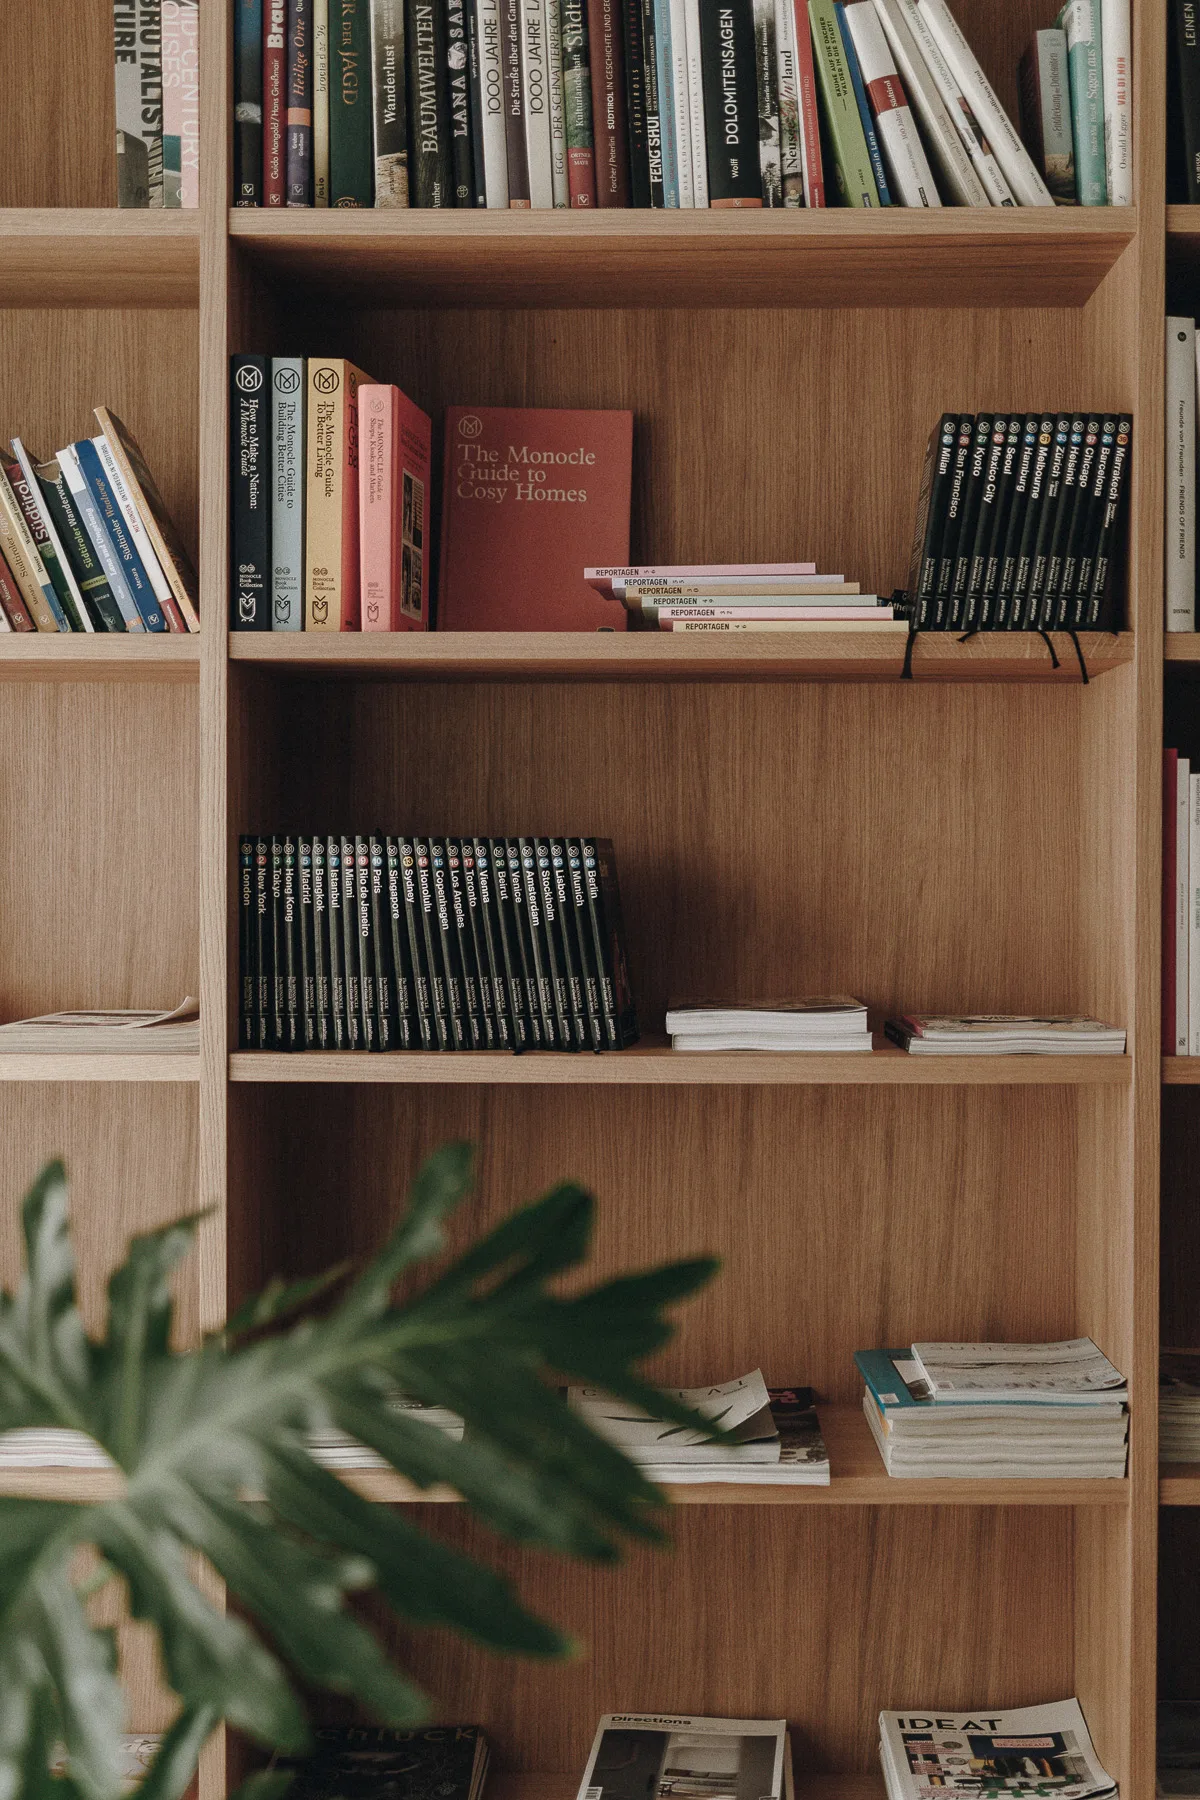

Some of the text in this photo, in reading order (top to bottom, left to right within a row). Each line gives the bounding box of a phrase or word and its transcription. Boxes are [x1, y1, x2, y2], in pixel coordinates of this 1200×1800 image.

[603, 14, 611, 31] UND
[1183, 3, 1197, 47] LEINEN
[292, 18, 308, 96] Heilige Orte
[337, 22, 358, 105] DER JAGD
[484, 19, 501, 115] 1000 JAHRE
[508, 24, 521, 115] Die Straße über den
[527, 19, 544, 115] 1000 JAHRE
[604, 34, 613, 80] GESCHICHTE
[271, 59, 279, 96] Grießmair
[383, 45, 396, 124] Wanderlust
[416, 5, 438, 153] BAUMWELTEN
[569, 54, 584, 126] Kulturlandschaft
[719, 9, 739, 178] Wolff DOLOMITENSAGEN
[884, 80, 898, 107] Südtirol
[1118, 78, 1126, 87] DI
[452, 76, 468, 137] LANA
[606, 92, 615, 129] SÜDTIROL
[1118, 90, 1126, 105] VAL
[1119, 113, 1128, 137] Egger
[552, 116, 564, 174] EGG DER
[647, 116, 662, 183] FENG SHUI
[869, 131, 887, 188] Kirchen in Lana
[1118, 140, 1127, 169] Oswald
[271, 157, 279, 179] Guido
[240, 408, 249, 446] Monocle
[249, 398, 258, 420] How
[249, 422, 257, 433] to
[1179, 400, 1187, 429] Freunde
[101, 444, 113, 466] SÜDTIROL
[249, 436, 259, 462] Make
[276, 402, 287, 502] Building Better Cities
[286, 402, 296, 509] The Monocle Guide to
[315, 402, 326, 478] To Better Living
[324, 402, 335, 497] The Monocle Guide
[458, 444, 596, 465] The Monocle
[240, 449, 250, 476] Guide
[458, 462, 546, 482] Guide to
[938, 447, 951, 475] Milan
[972, 447, 987, 477] Kyoto
[983, 446, 1001, 503] Mexico City
[1003, 446, 1015, 475] Seoul
[1016, 447, 1034, 492] Hamburg
[1031, 446, 1048, 499] Melbourne
[1051, 446, 1065, 477] Zürich
[1065, 446, 1080, 485] Helsinki
[1078, 447, 1094, 488] Chicago
[1093, 447, 1110, 497] Barcelona
[1109, 447, 1125, 500] Marrakech
[112, 472, 127, 501] UNTERWEGS
[249, 473, 260, 509] Nation:
[457, 481, 587, 503] Cosy Homes
[948, 448, 968, 518] San Francisco
[13, 479, 49, 540] Südtirol
[1179, 517, 1186, 528] OF
[72, 527, 94, 568] Südtiroler
[85, 507, 118, 576] Lana und Umgebung
[94, 477, 143, 589] Menara Südtiroler Waalwege
[6, 537, 29, 578] Südtiroler
[596, 568, 639, 577] REPORTAGEN
[174, 580, 185, 600] Menara
[624, 578, 668, 586] REPORTAGEN
[638, 587, 682, 595] REPORTAGEN
[653, 597, 697, 605] REPORTAGEN
[671, 608, 715, 616] REPORTAGEN
[685, 622, 730, 630] REPORTAGEN
[243, 868, 251, 906] London
[257, 868, 266, 914] New York
[272, 868, 282, 898] Tokyo
[283, 868, 295, 922] Hong Kong
[302, 869, 311, 904] Madrid
[314, 869, 324, 912] Bangkok
[330, 869, 339, 908] Istanbul
[345, 869, 354, 898] Miami
[373, 869, 382, 894] Paris
[389, 870, 400, 919] Singapore
[404, 869, 415, 903] Sydney
[419, 870, 432, 912] Honolulu
[435, 870, 450, 930] Copenhagen
[451, 870, 465, 928] Los Angeles
[465, 870, 477, 907] Toronto
[479, 870, 491, 903] Vienna
[497, 871, 509, 900] Beirut
[511, 871, 523, 903] Venice
[526, 871, 541, 926] Amsterdam
[540, 870, 555, 921] Stockholm
[555, 870, 567, 902] Lisbon
[571, 871, 585, 906] Munich
[587, 870, 599, 899] Berlin
[360, 869, 370, 937] Rio de Janeiro
[611, 1715, 692, 1725] Directions
[897, 1718, 1002, 1731] IDEAT
